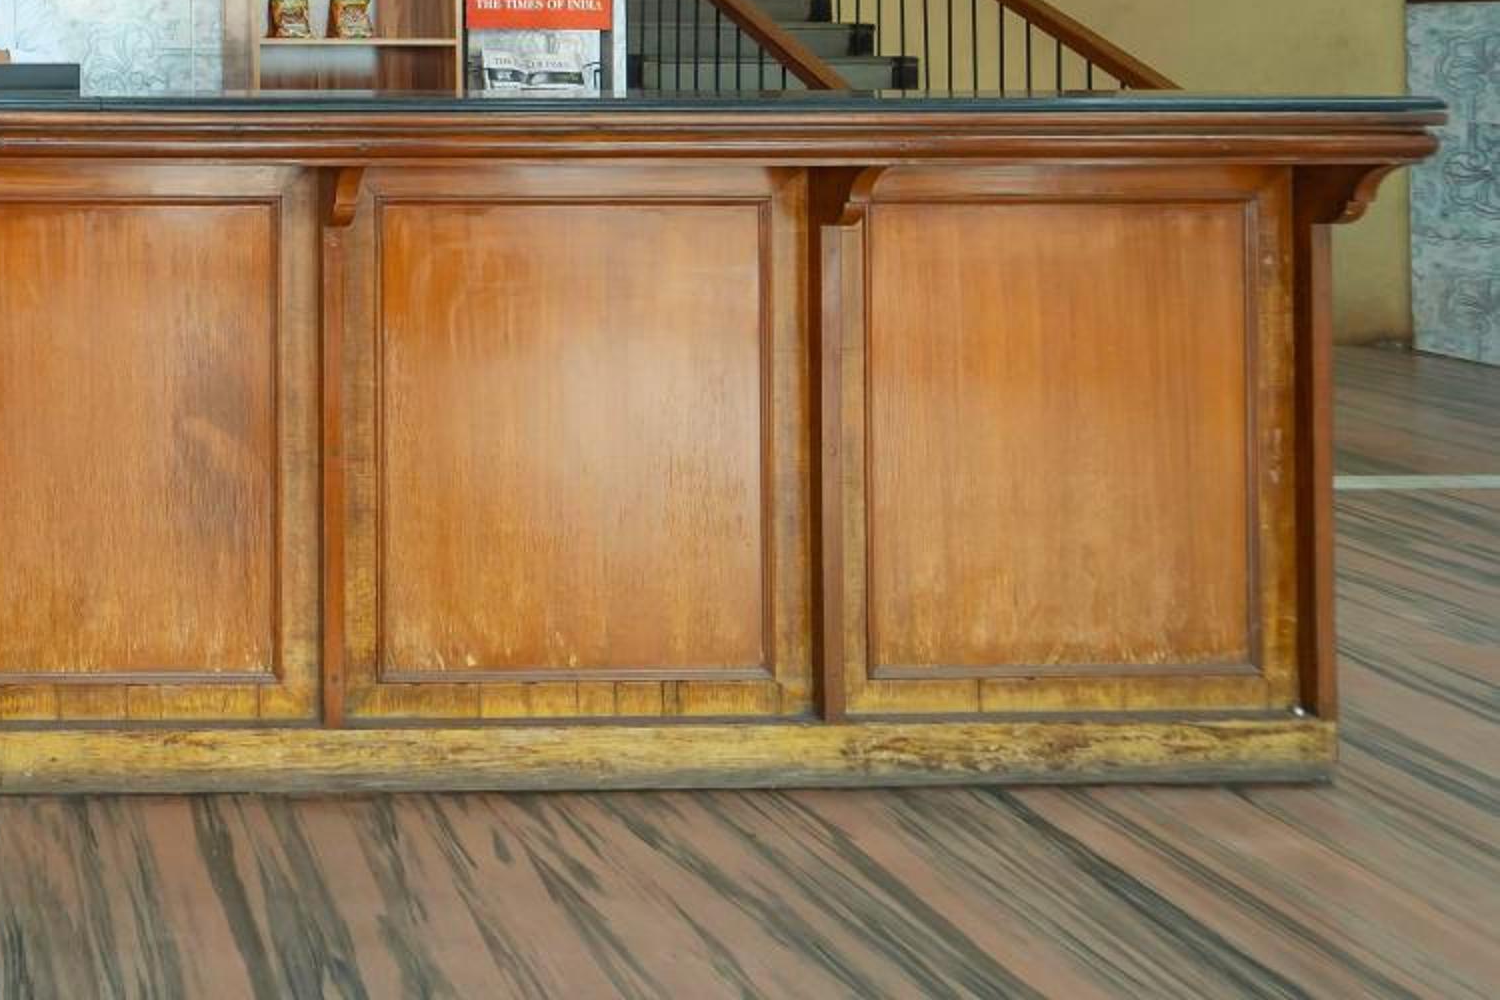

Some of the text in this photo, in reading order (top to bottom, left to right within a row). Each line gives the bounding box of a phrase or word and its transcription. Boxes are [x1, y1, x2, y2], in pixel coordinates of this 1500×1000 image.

[507, 0, 544, 10] TIMES
[547, 0, 562, 10] OF
[567, 0, 603, 11] INDIA
